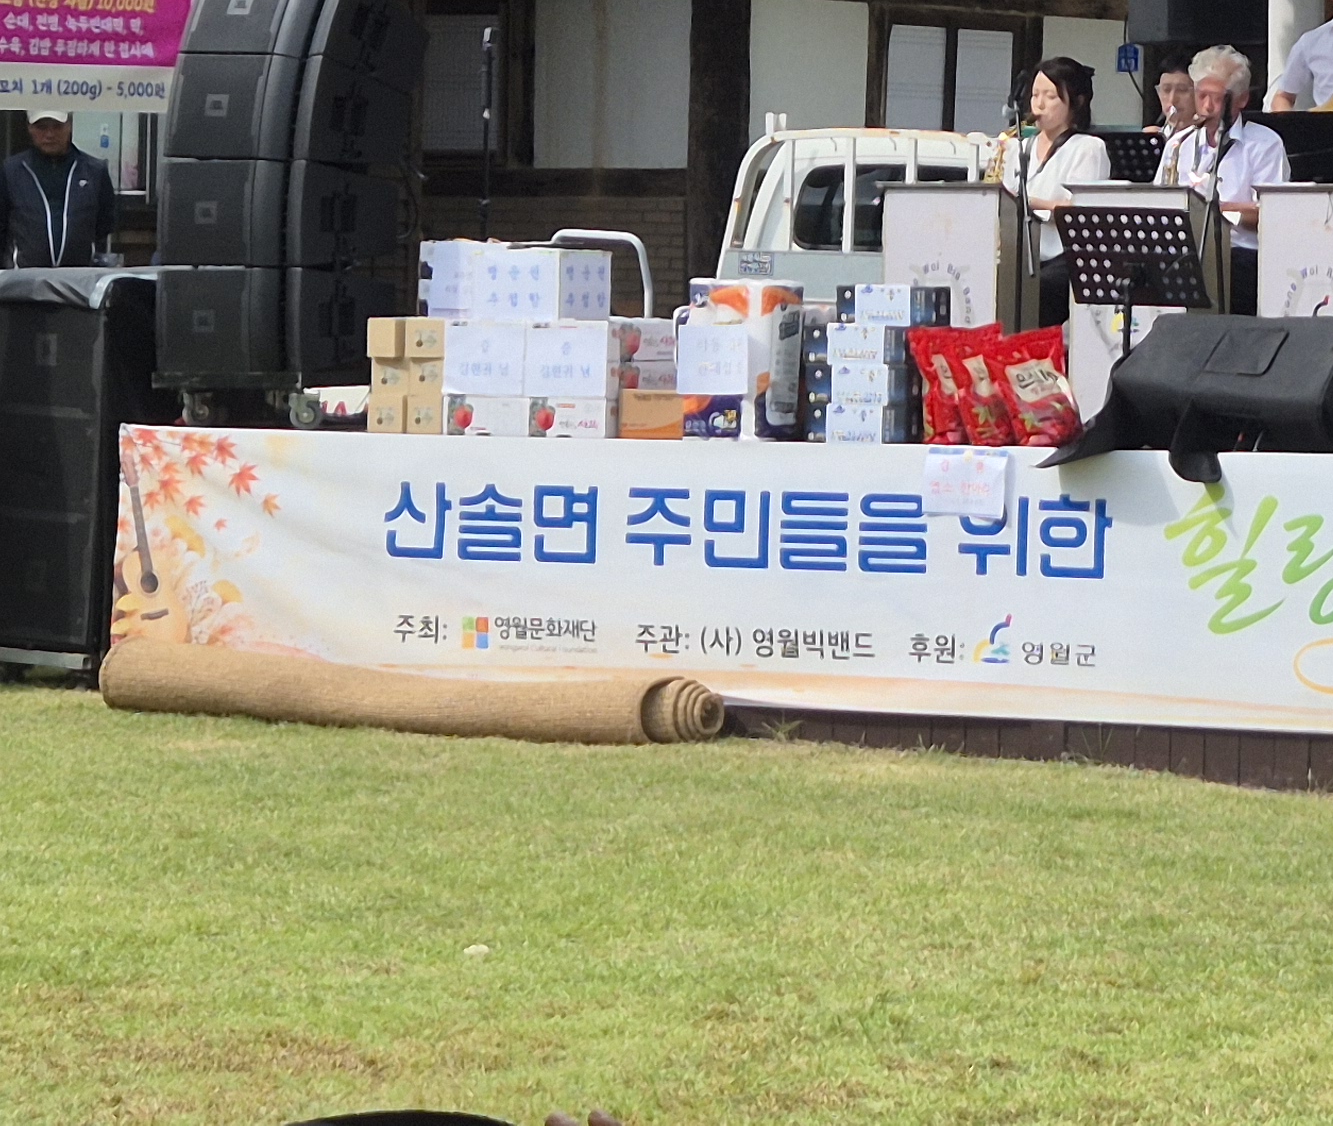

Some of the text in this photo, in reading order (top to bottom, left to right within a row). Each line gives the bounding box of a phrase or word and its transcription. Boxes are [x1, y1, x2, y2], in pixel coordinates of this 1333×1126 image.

[32, 79, 53, 95] 1개
[57, 79, 103, 100] (200g)
[116, 80, 166, 100] 5,000원
[383, 480, 599, 565] 산솔면
[624, 487, 928, 575] 주민들을
[958, 493, 1113, 579] 위한
[393, 614, 448, 644] 주최:
[494, 616, 597, 643] 영월문화재단
[635, 623, 876, 661] 주관: (사) 영월빅밴드
[908, 633, 966, 664] 후원:
[1021, 641, 1096, 668] 영월군
